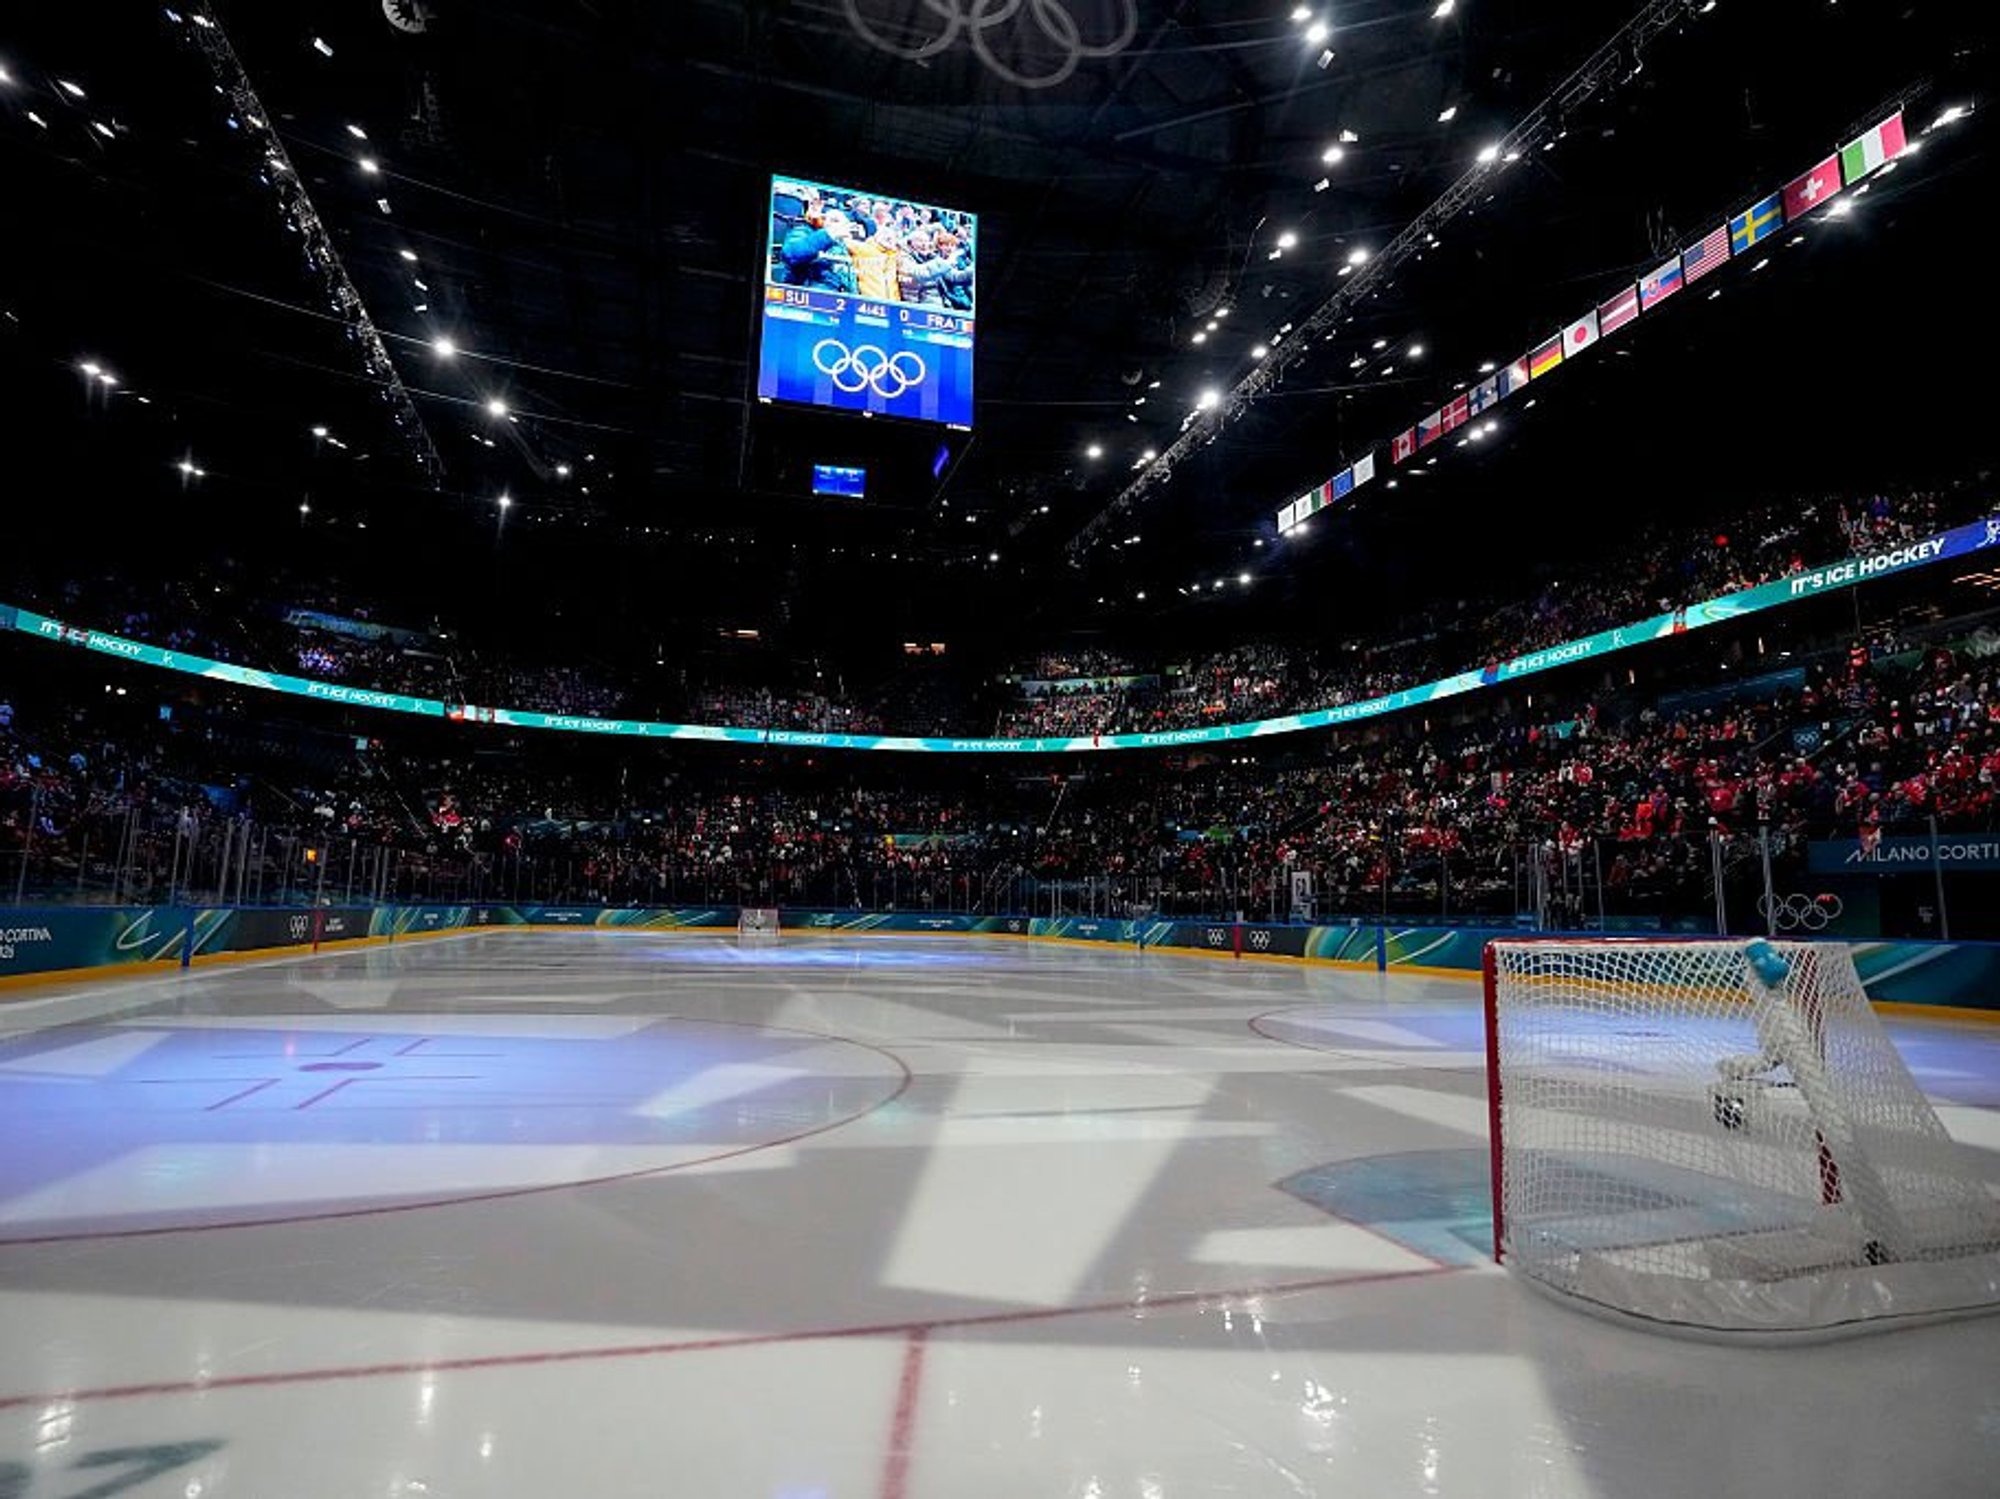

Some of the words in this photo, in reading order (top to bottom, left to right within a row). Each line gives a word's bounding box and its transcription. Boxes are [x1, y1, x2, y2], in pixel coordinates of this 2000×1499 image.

[785, 290, 809, 306] SUI
[835, 298, 846, 311] 2
[899, 309, 909, 322] 0
[926, 314, 955, 330] FRA
[1791, 574, 1825, 595] IT'S
[1826, 564, 1856, 585] ICE
[1859, 537, 1946, 576] HOCKEY
[1547, 641, 1593, 663] HOCKEY
[1844, 843, 1930, 864] MILANO
